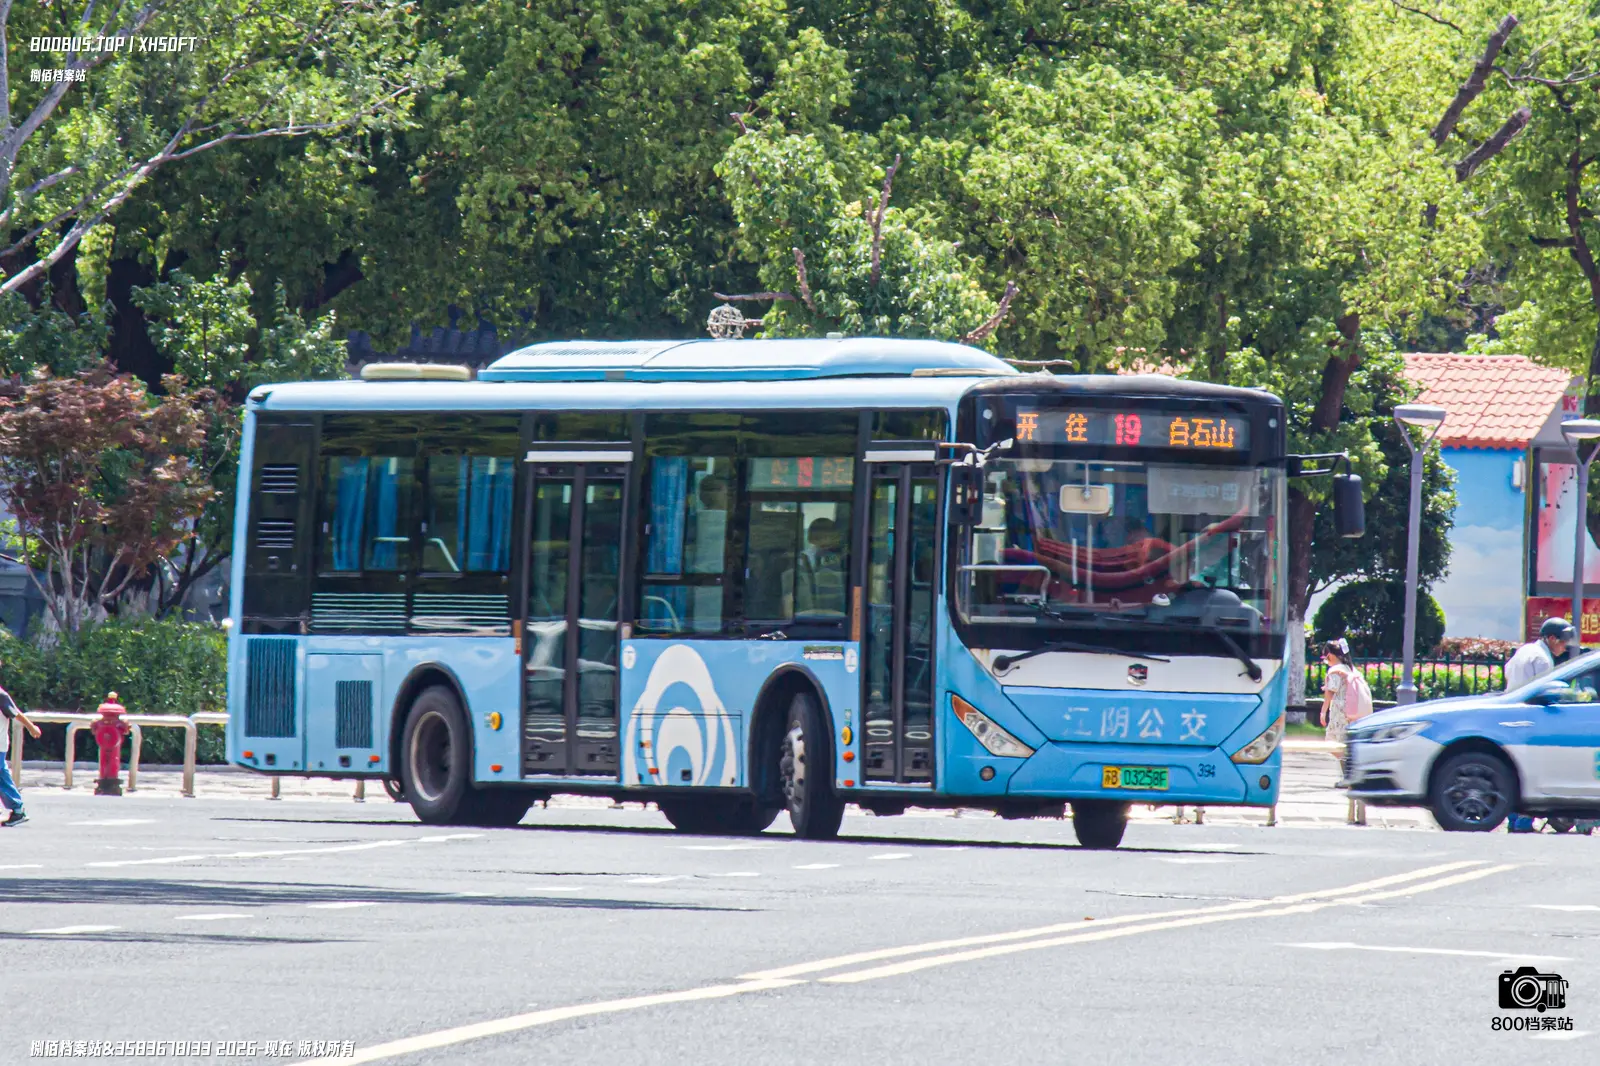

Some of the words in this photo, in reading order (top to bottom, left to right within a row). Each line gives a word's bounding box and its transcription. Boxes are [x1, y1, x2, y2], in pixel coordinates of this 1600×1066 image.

[1114, 413, 1142, 445] 19
[1169, 416, 1234, 448] 白石山
